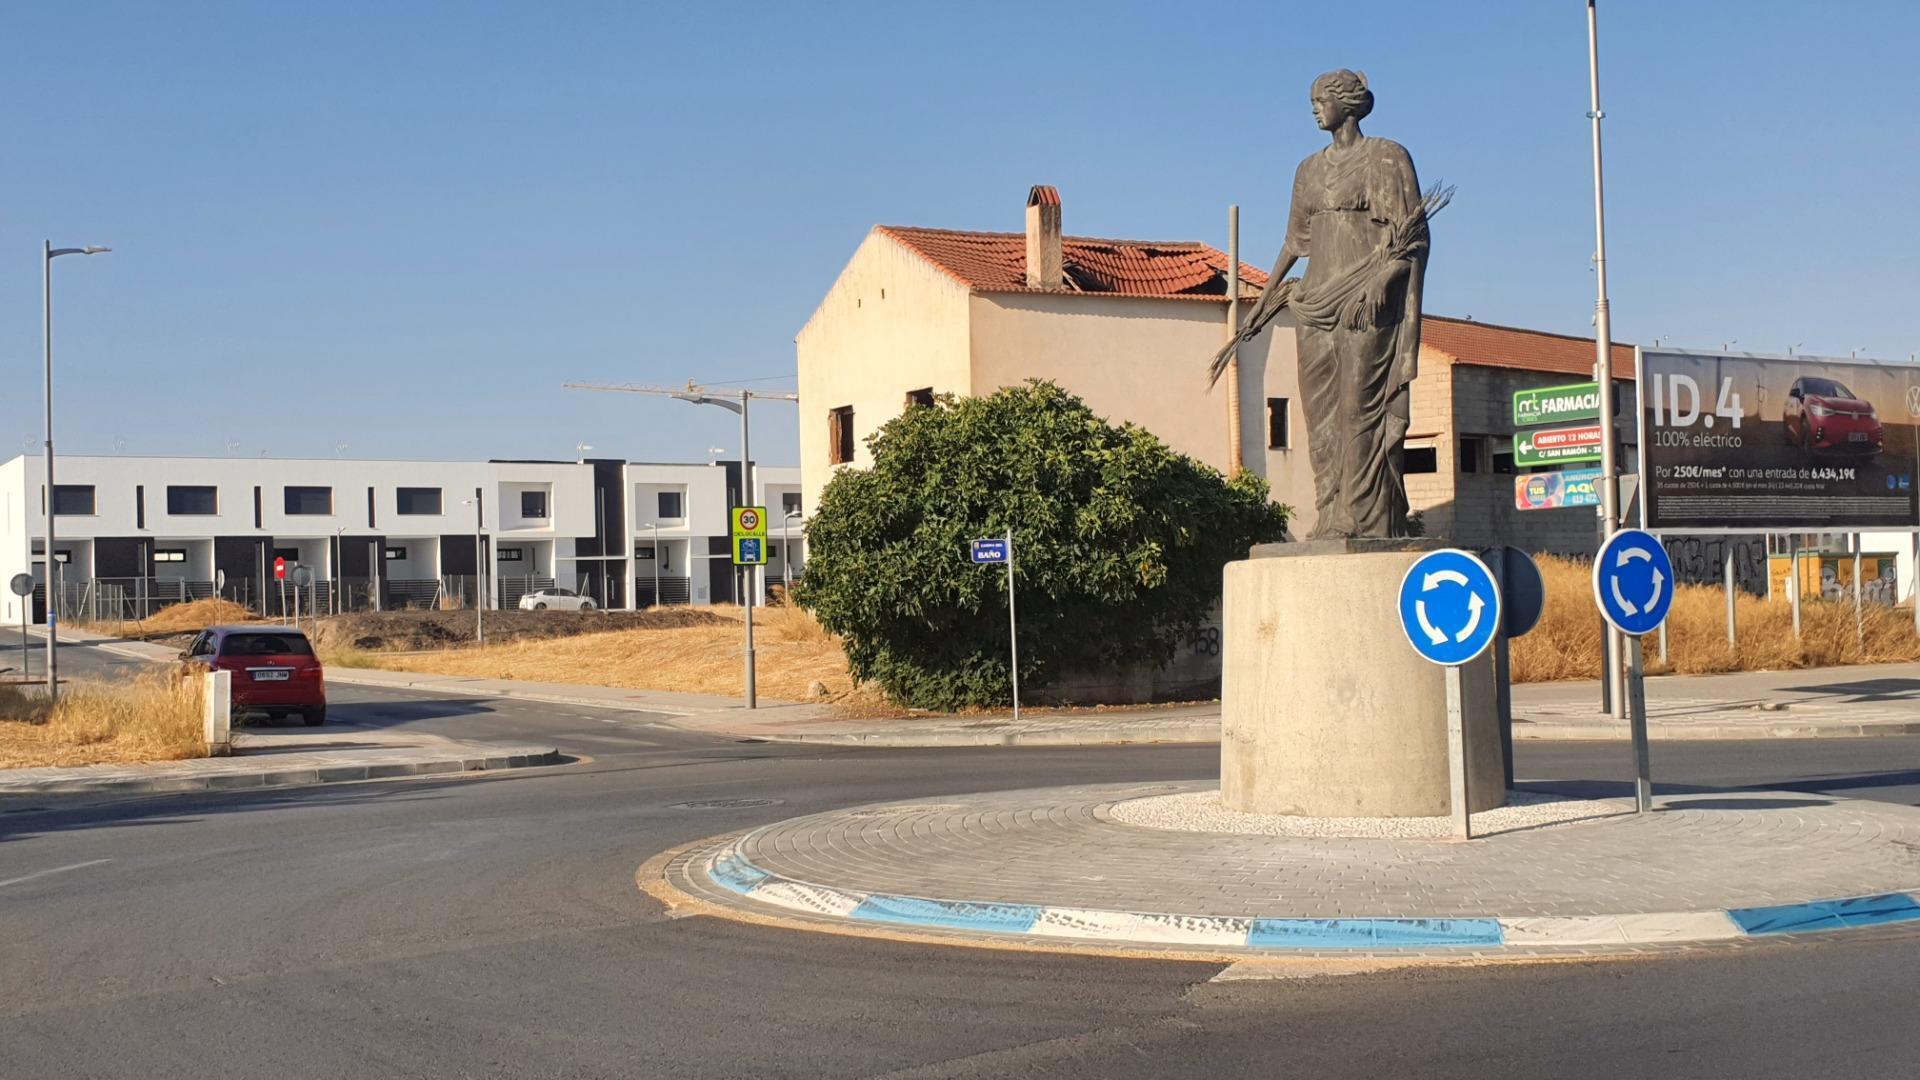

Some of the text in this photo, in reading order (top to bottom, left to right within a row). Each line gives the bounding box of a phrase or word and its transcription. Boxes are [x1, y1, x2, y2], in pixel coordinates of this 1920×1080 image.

[1542, 394, 1600, 413] FARMACIA
[1654, 373, 1744, 428] ID.4
[1538, 435, 1566, 445] ABIERTO
[1568, 434, 1577, 442] 12
[1655, 432, 1742, 448] 100% eléctrico
[1539, 450, 1546, 459] C/
[1547, 449, 1560, 458] SAN
[1561, 446, 1587, 456] RAMÓN
[1656, 465, 1671, 478] Por
[1728, 468, 1745, 478] con
[1747, 468, 1763, 478] una
[1765, 467, 1797, 479] entrada
[1799, 467, 1810, 479] de
[1529, 487, 1545, 496] TUS
[743, 515, 755, 524] 30
[978, 550, 1001, 559] BAÑO
